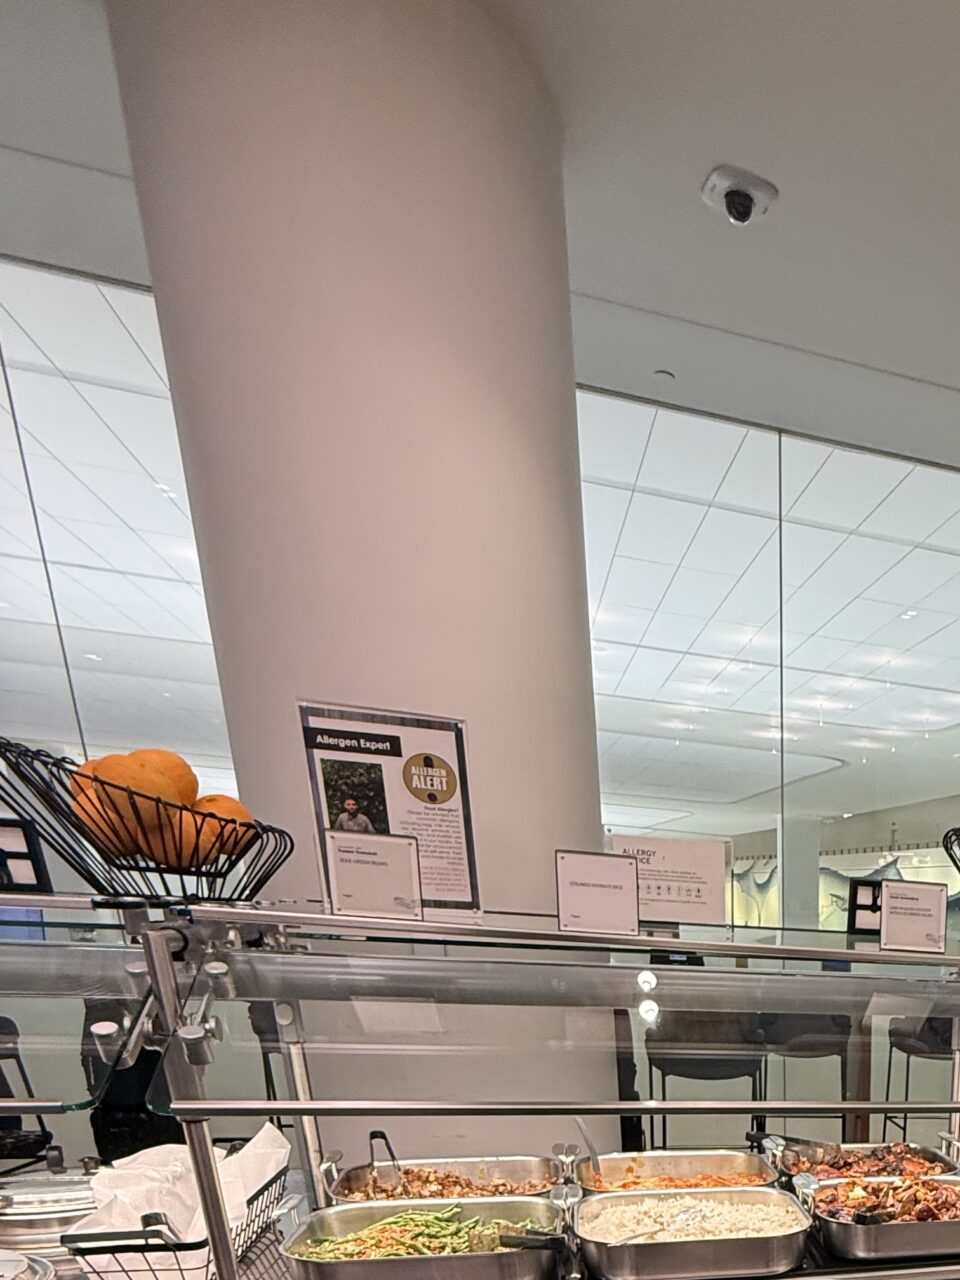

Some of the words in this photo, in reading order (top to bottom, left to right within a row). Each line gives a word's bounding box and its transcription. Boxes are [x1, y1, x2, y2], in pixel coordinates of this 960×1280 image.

[316, 735, 358, 747] Allergen
[360, 739, 391, 750] Expert
[411, 766, 447, 777] ALLERGEN
[412, 777, 448, 791] ALERT
[623, 848, 657, 857] ALLERGY
